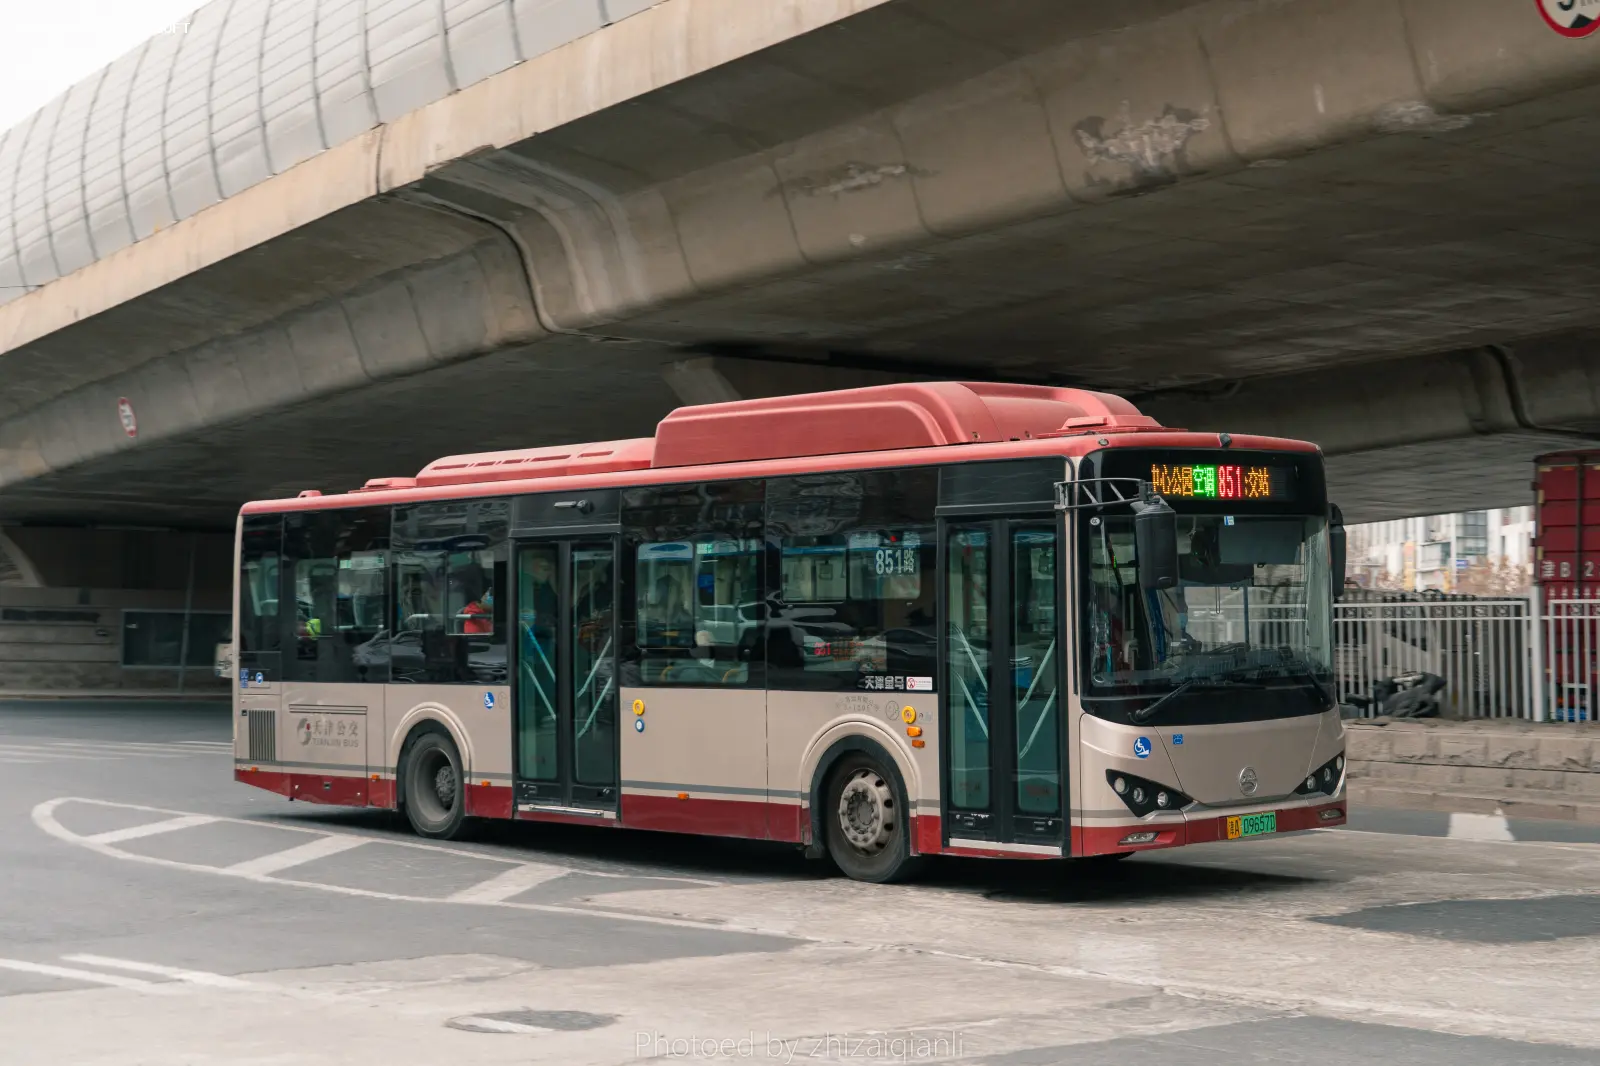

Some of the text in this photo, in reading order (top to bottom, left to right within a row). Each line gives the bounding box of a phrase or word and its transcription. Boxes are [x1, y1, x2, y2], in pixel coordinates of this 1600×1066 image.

[1218, 465, 1241, 497] 851
[875, 547, 915, 575] 851路
[312, 720, 358, 737] 天津公交
[343, 738, 359, 747] BUS
